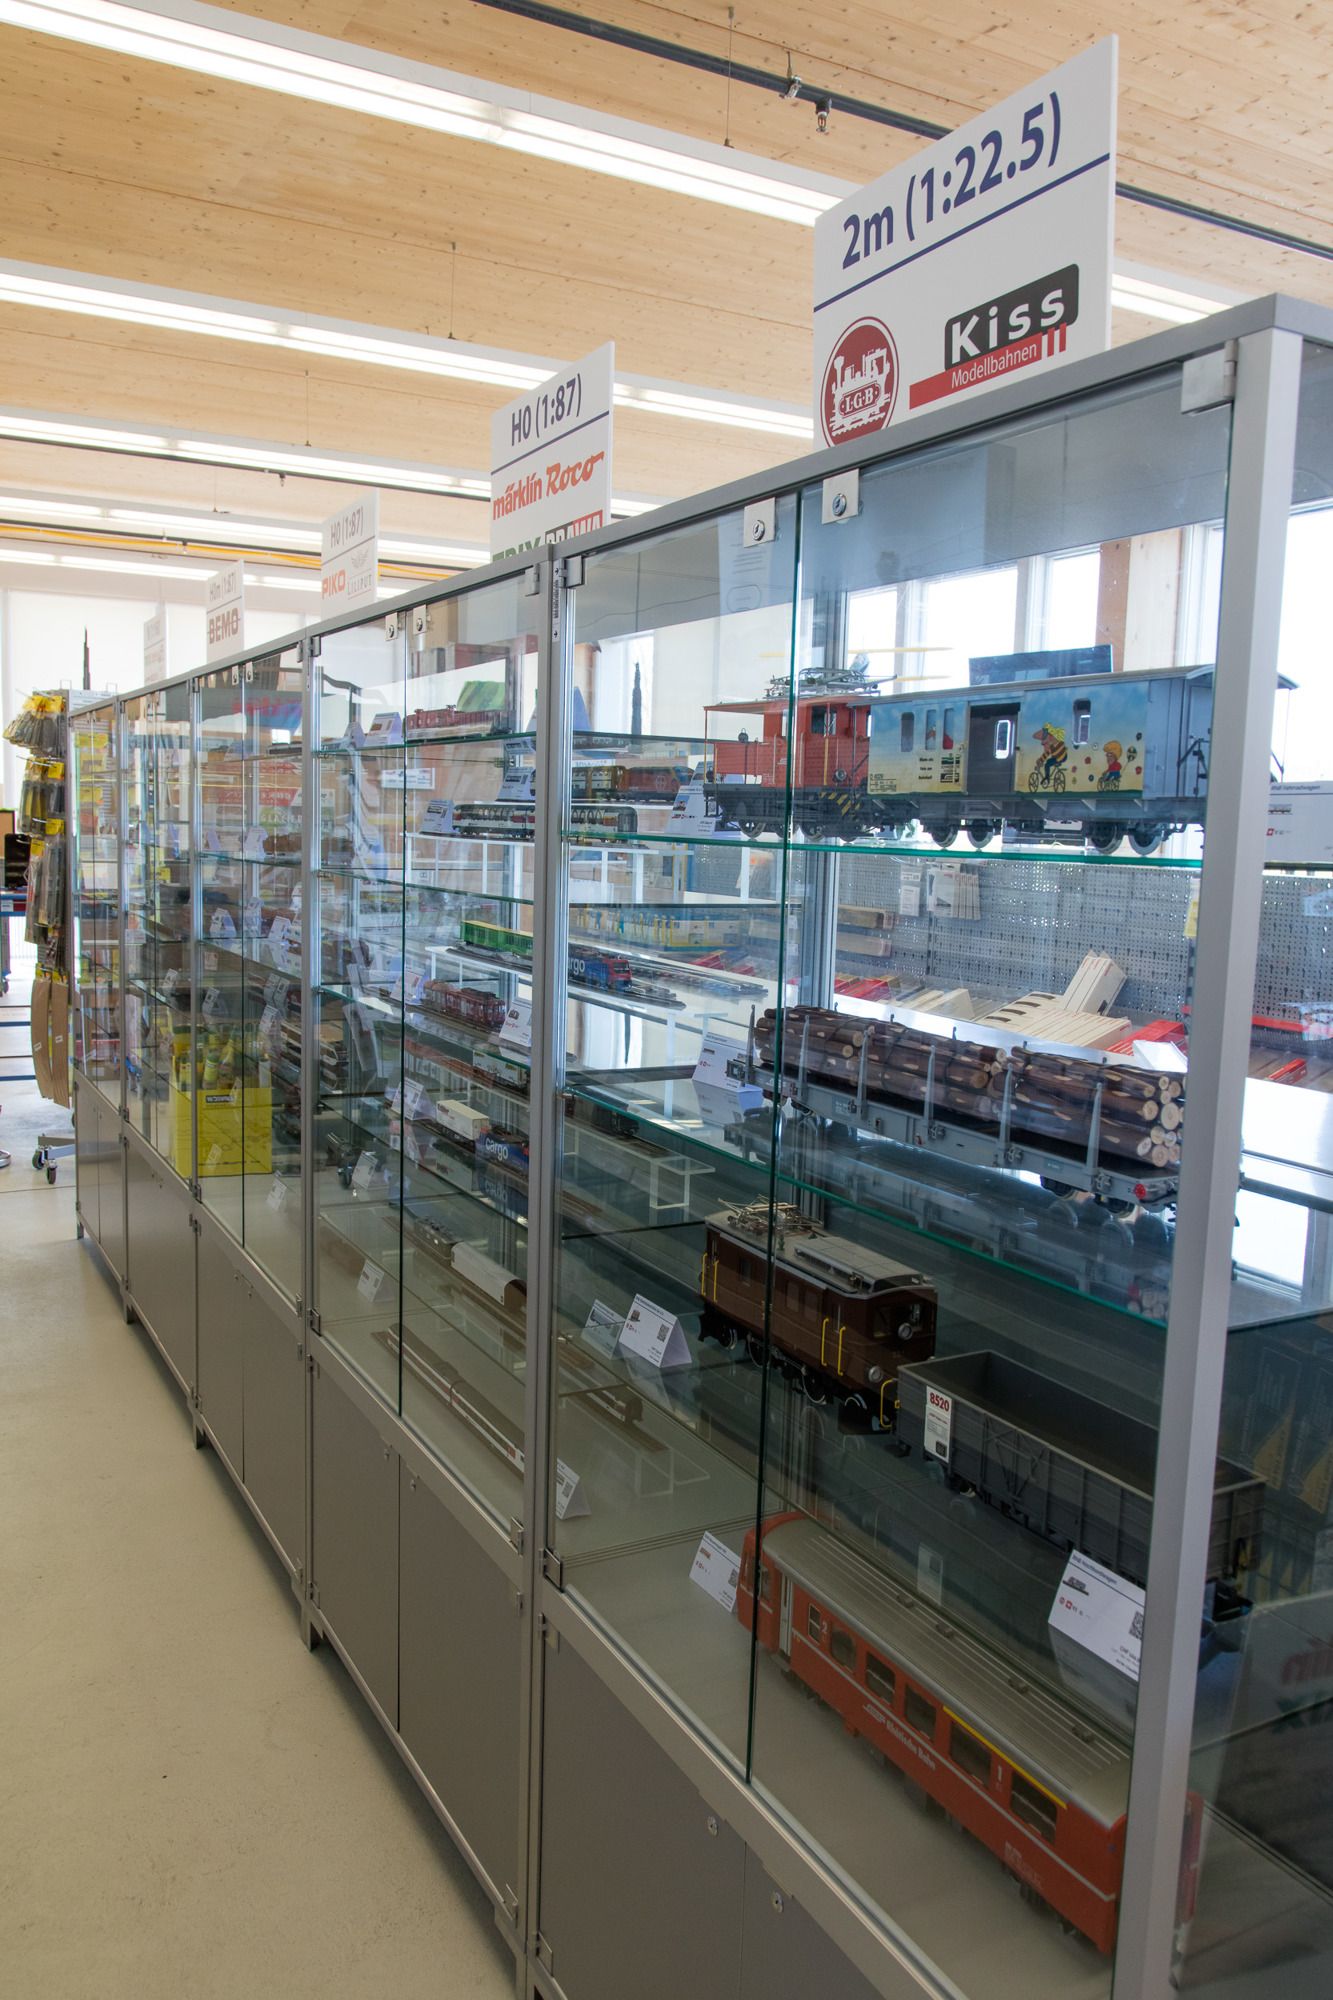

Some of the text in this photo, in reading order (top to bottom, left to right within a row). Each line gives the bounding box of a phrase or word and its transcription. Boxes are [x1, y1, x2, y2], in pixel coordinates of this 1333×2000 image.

[842, 91, 1062, 270] 2m (1:22.5)
[951, 288, 1065, 365] Kiss
[950, 341, 1038, 389] Modellbahnen
[536, 373, 582, 438] (1:87)
[546, 451, 605, 497] Roco
[342, 505, 364, 546] (1:87)
[322, 569, 372, 600] PIKO LILIPUT
[209, 608, 239, 645] BEMO
[485, 1137, 509, 1161] cargo
[929, 1391, 950, 1412] 8520
[821, 1620, 828, 1635] 2
